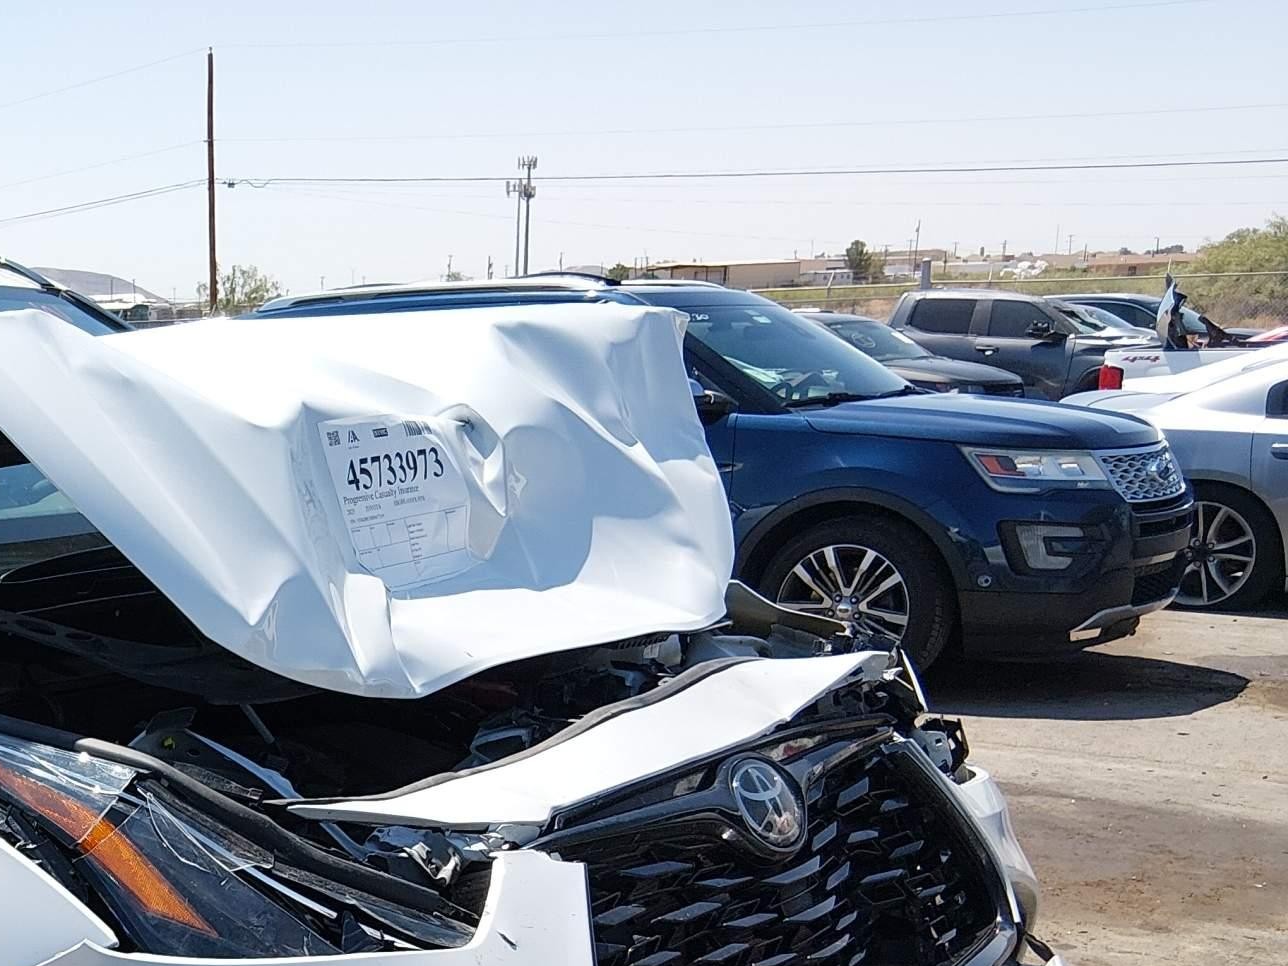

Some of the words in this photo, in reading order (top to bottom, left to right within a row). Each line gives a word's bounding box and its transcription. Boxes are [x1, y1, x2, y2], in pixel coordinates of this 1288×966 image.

[347, 447, 444, 491] 45733973
[343, 493, 374, 506] Progressive
[374, 488, 397, 499] Casualty
